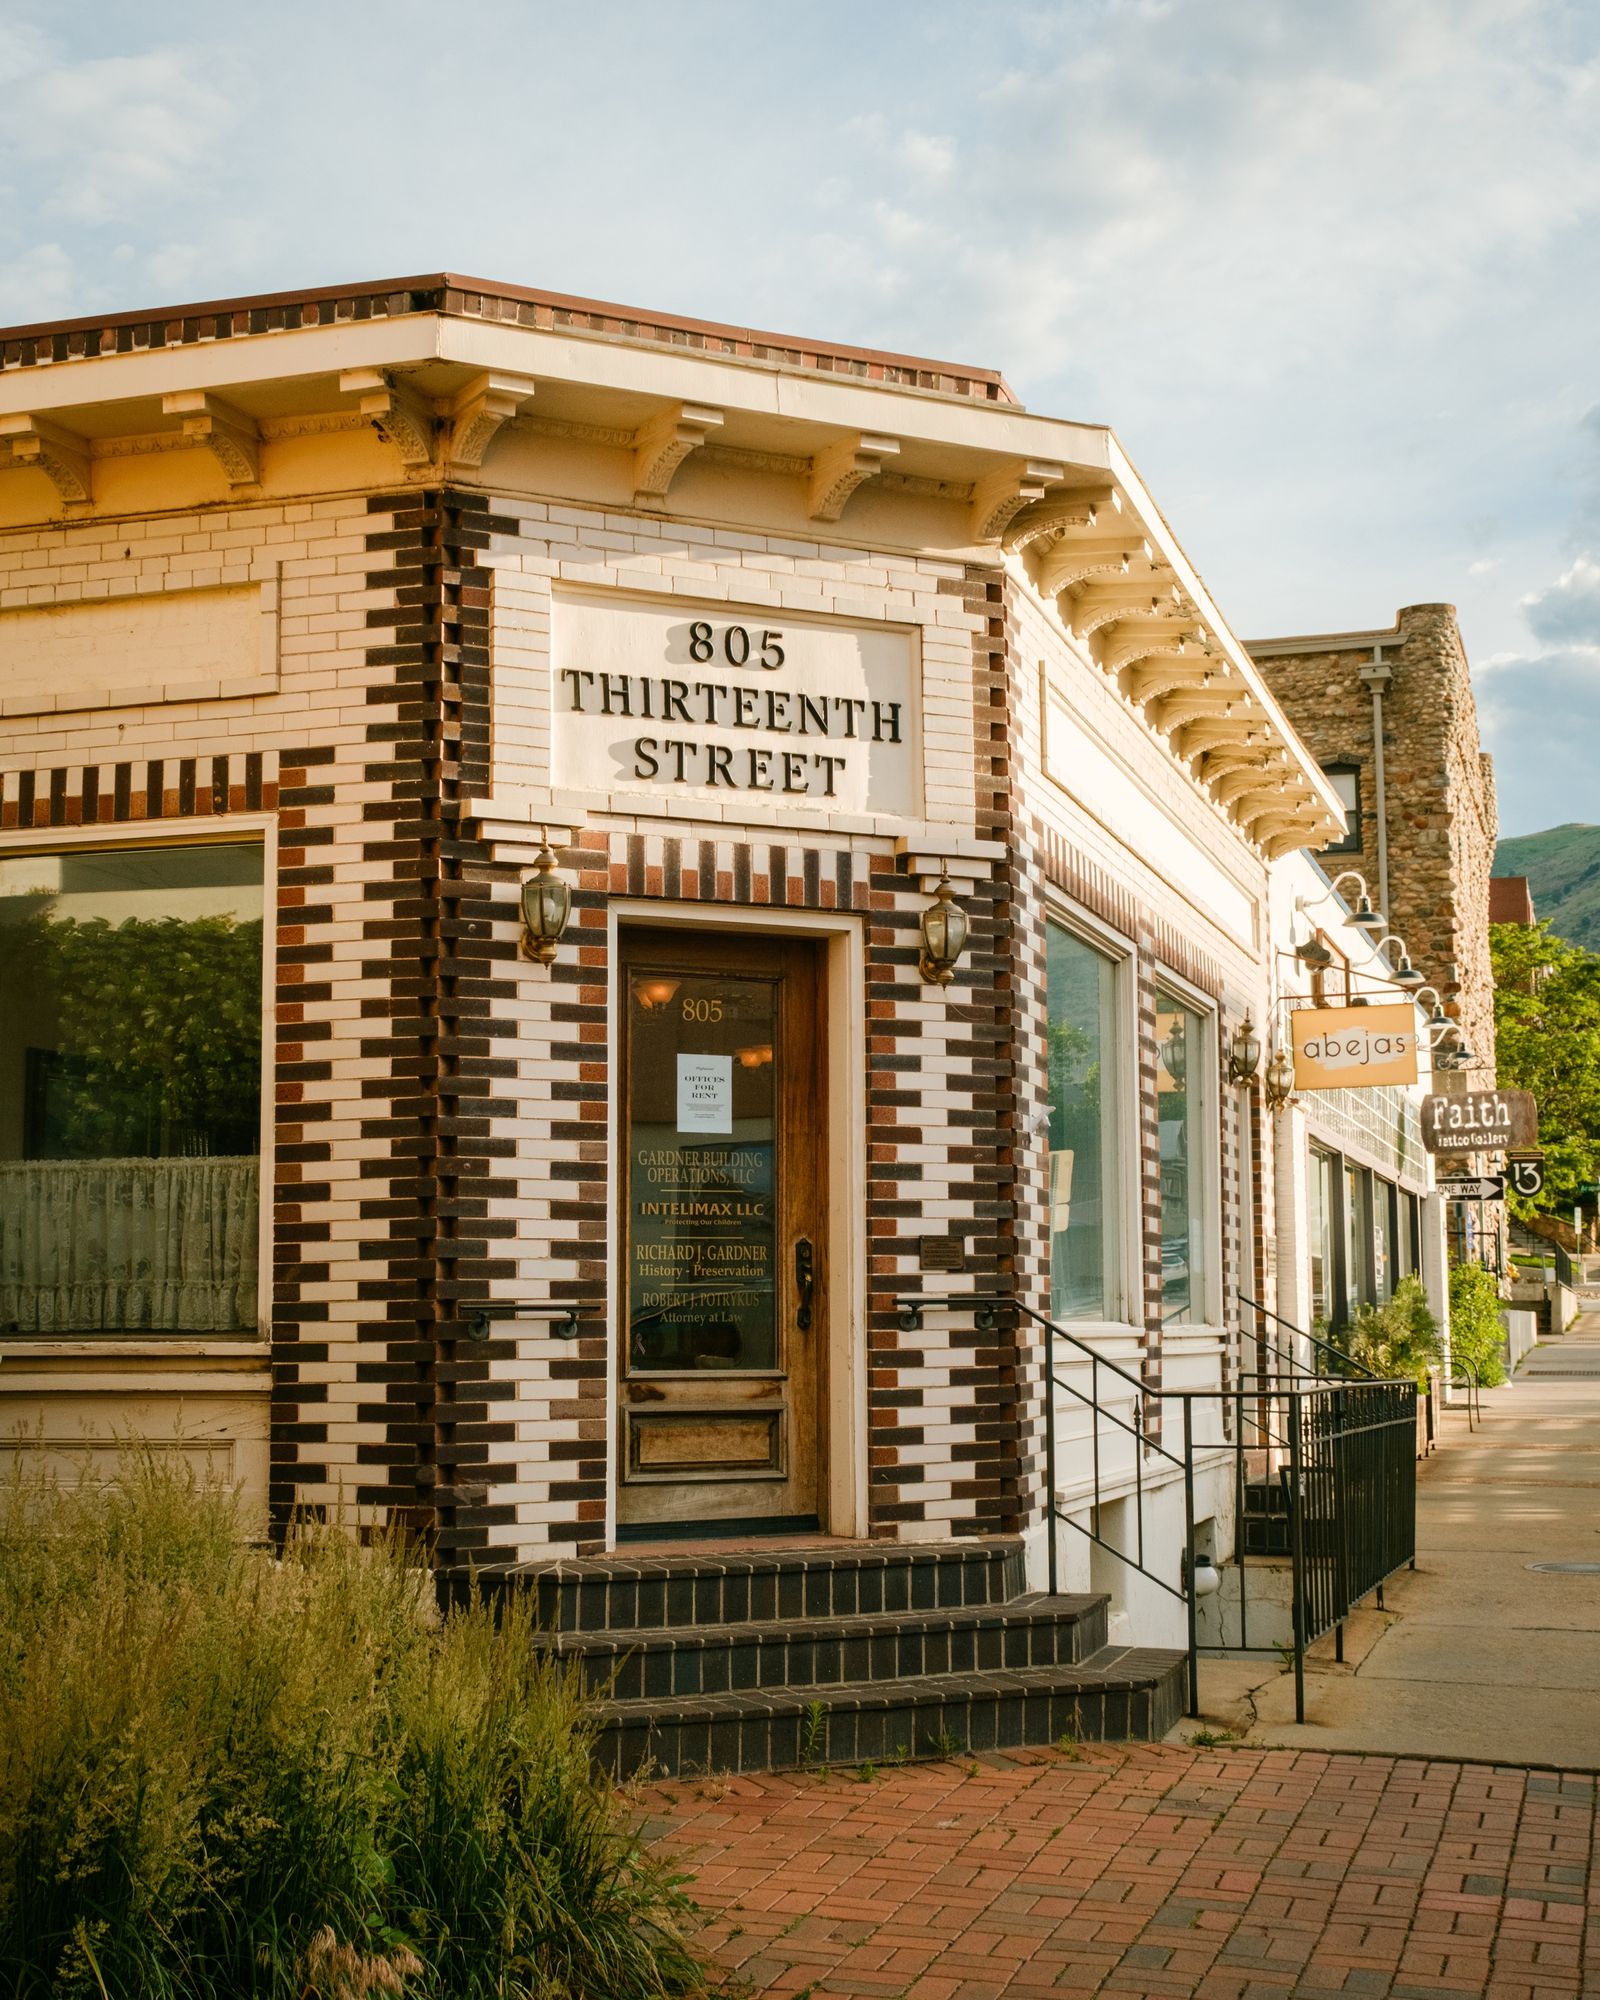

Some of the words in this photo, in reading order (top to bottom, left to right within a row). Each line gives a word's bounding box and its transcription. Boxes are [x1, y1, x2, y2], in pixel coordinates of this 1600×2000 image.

[689, 621, 785, 671] 805
[561, 668, 902, 743] THIRTEENTH
[634, 737, 846, 797] STREET
[682, 998, 723, 1023] 805
[1304, 1030, 1406, 1065] abejas
[1432, 1094, 1511, 1130] Faith
[638, 1150, 699, 1166] GARDNER
[703, 1152, 763, 1168] BUILDING
[647, 1167, 730, 1186] OPERATIONS,
[732, 1169, 754, 1184] LLC
[1513, 1163, 1541, 1194] 13
[1438, 1185, 1456, 1195] ONE
[1461, 1185, 1480, 1194] WAY
[641, 1202, 731, 1216] INTELIMAX
[737, 1203, 764, 1216] LLC
[665, 1219, 699, 1227] Protecting
[636, 1244, 694, 1260] RICHARD
[696, 1245, 705, 1264] J.
[707, 1245, 767, 1261] GARDNER
[639, 1264, 683, 1279] History
[693, 1264, 764, 1277] Preservation
[642, 1292, 688, 1307] ROBERT
[691, 1293, 698, 1310] J.
[659, 1312, 706, 1326] Attorney
[708, 1313, 719, 1323] at
[721, 1312, 743, 1323] Law
